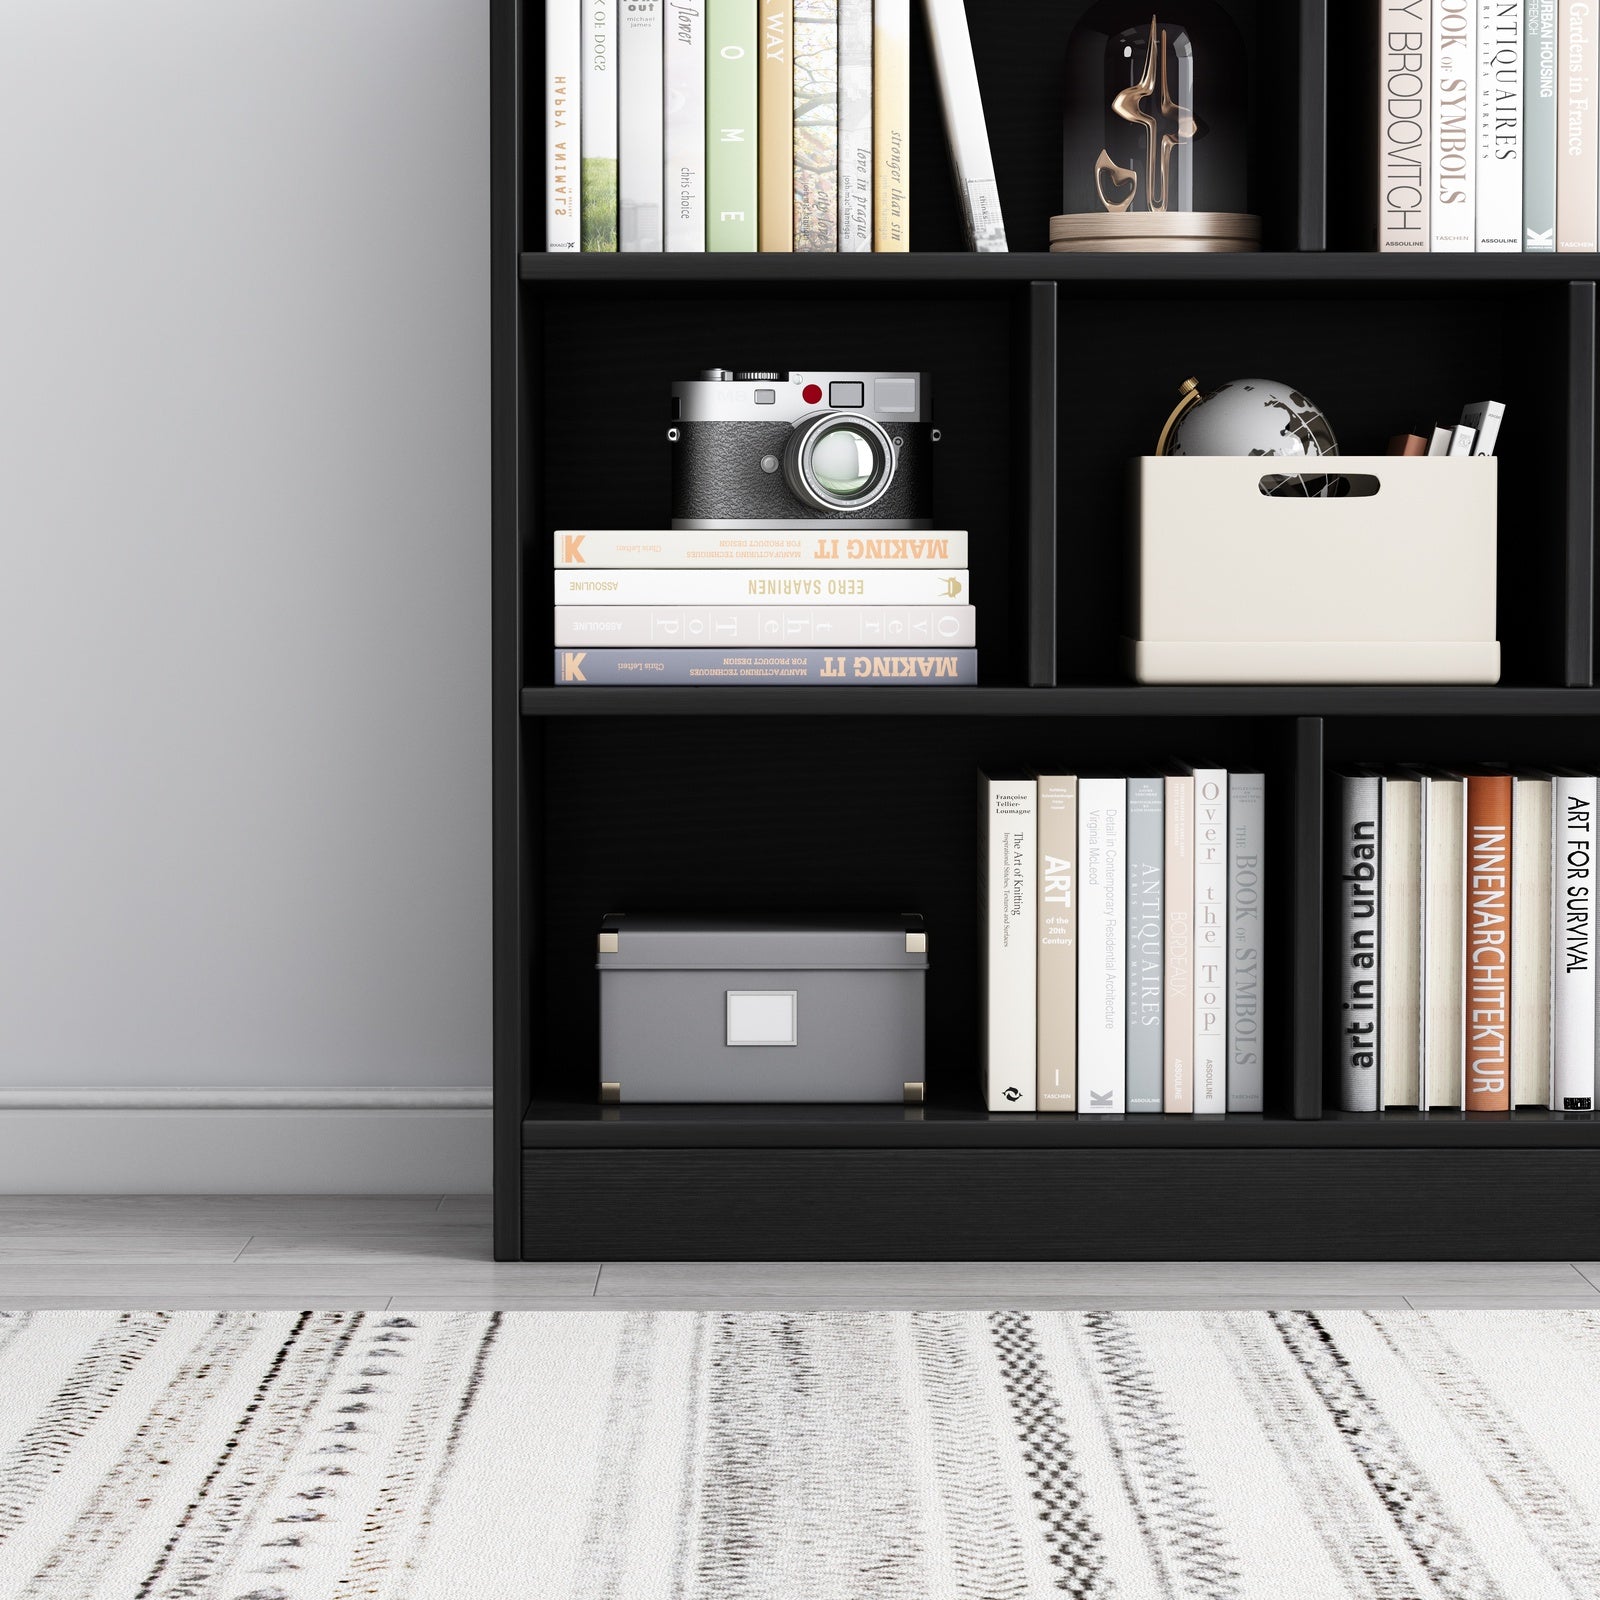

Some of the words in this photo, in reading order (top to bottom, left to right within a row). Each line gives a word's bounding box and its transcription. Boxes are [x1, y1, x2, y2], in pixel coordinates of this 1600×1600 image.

[628, 3, 654, 11] out
[670, 2, 699, 45] flower
[767, 12, 784, 63] WAY
[1569, 2, 1588, 72] Gardens
[1441, 57, 1452, 72] OF
[1539, 41, 1553, 98] HOUSING
[1569, 77, 1588, 93] in
[1387, 32, 1423, 230] BRODOVITCH
[1440, 79, 1466, 204] SYMBOLS
[1569, 99, 1588, 156] France
[857, 148, 871, 173] love
[886, 130, 901, 184] stronger
[681, 168, 695, 188] chris
[857, 178, 870, 191] in
[681, 191, 695, 219] choice
[849, 195, 867, 240] prague
[891, 189, 906, 217] than
[891, 222, 901, 241] sin
[814, 539, 839, 559] IT
[847, 539, 949, 559] MAKING
[570, 582, 618, 591] ASSOULINE
[749, 580, 821, 595] SAARINEN
[828, 580, 864, 595] EERO
[573, 622, 623, 631] ASSOULINE
[656, 616, 738, 637] Top
[765, 617, 833, 635] the
[865, 616, 960, 638] Over
[820, 656, 846, 678] IT
[853, 656, 958, 678] MAKING
[1087, 809, 1100, 844] Virginia
[1106, 810, 1117, 835] Detail
[1202, 782, 1219, 859] Over
[1568, 796, 1590, 832] ART
[1014, 832, 1023, 849] The
[1106, 839, 1116, 847] in
[1236, 825, 1247, 848] THE
[1014, 852, 1023, 865] Art
[1014, 868, 1023, 877] of
[1089, 848, 1099, 885] McLeod
[1342, 820, 1375, 918] urban
[1567, 841, 1589, 879] FOR
[1011, 880, 1023, 916] Knitting
[1045, 856, 1071, 907] ART
[1103, 850, 1117, 916] Contemporary
[1236, 854, 1257, 920] BOOK
[1204, 887, 1216, 943] the
[1566, 887, 1588, 973] SURVIVAL
[1042, 937, 1072, 946] Century
[1104, 920, 1116, 970] Residential
[1138, 863, 1160, 1026] ANTIQUAIRES
[1235, 927, 1246, 942] OF
[1352, 930, 1374, 968] an
[1169, 912, 1187, 997] BORDEAUX
[1472, 825, 1505, 1094] INNENARCHITEKTUR
[1104, 974, 1116, 1029] Architecture
[1202, 965, 1218, 1031] Top
[1235, 948, 1257, 1065] SYMBOLS
[1342, 980, 1374, 1010] in
[1347, 1021, 1374, 1068] art
[1174, 1059, 1183, 1101] ASSOULINE
